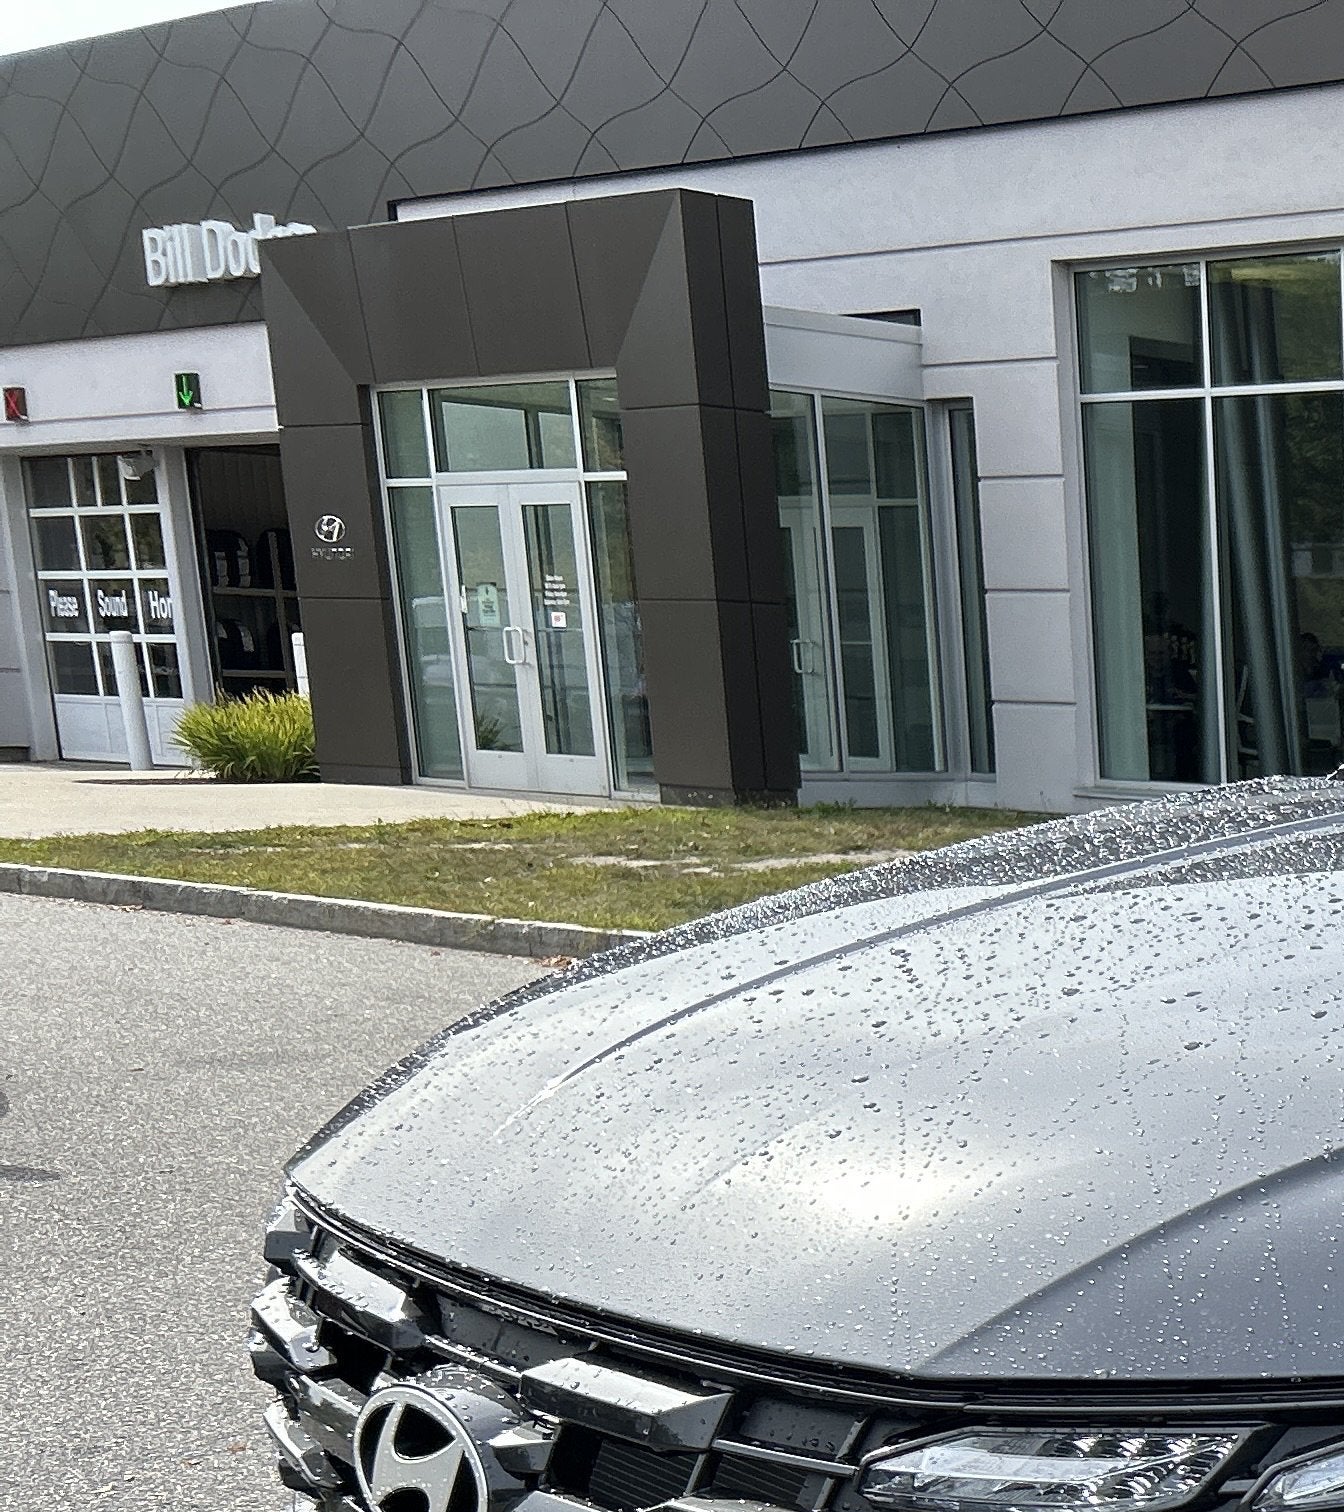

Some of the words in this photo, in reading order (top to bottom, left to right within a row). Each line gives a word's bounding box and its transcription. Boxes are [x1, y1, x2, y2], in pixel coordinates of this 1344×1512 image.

[142, 223, 199, 287] Bill
[48, 589, 79, 617] Please
[97, 589, 128, 617] Sound
